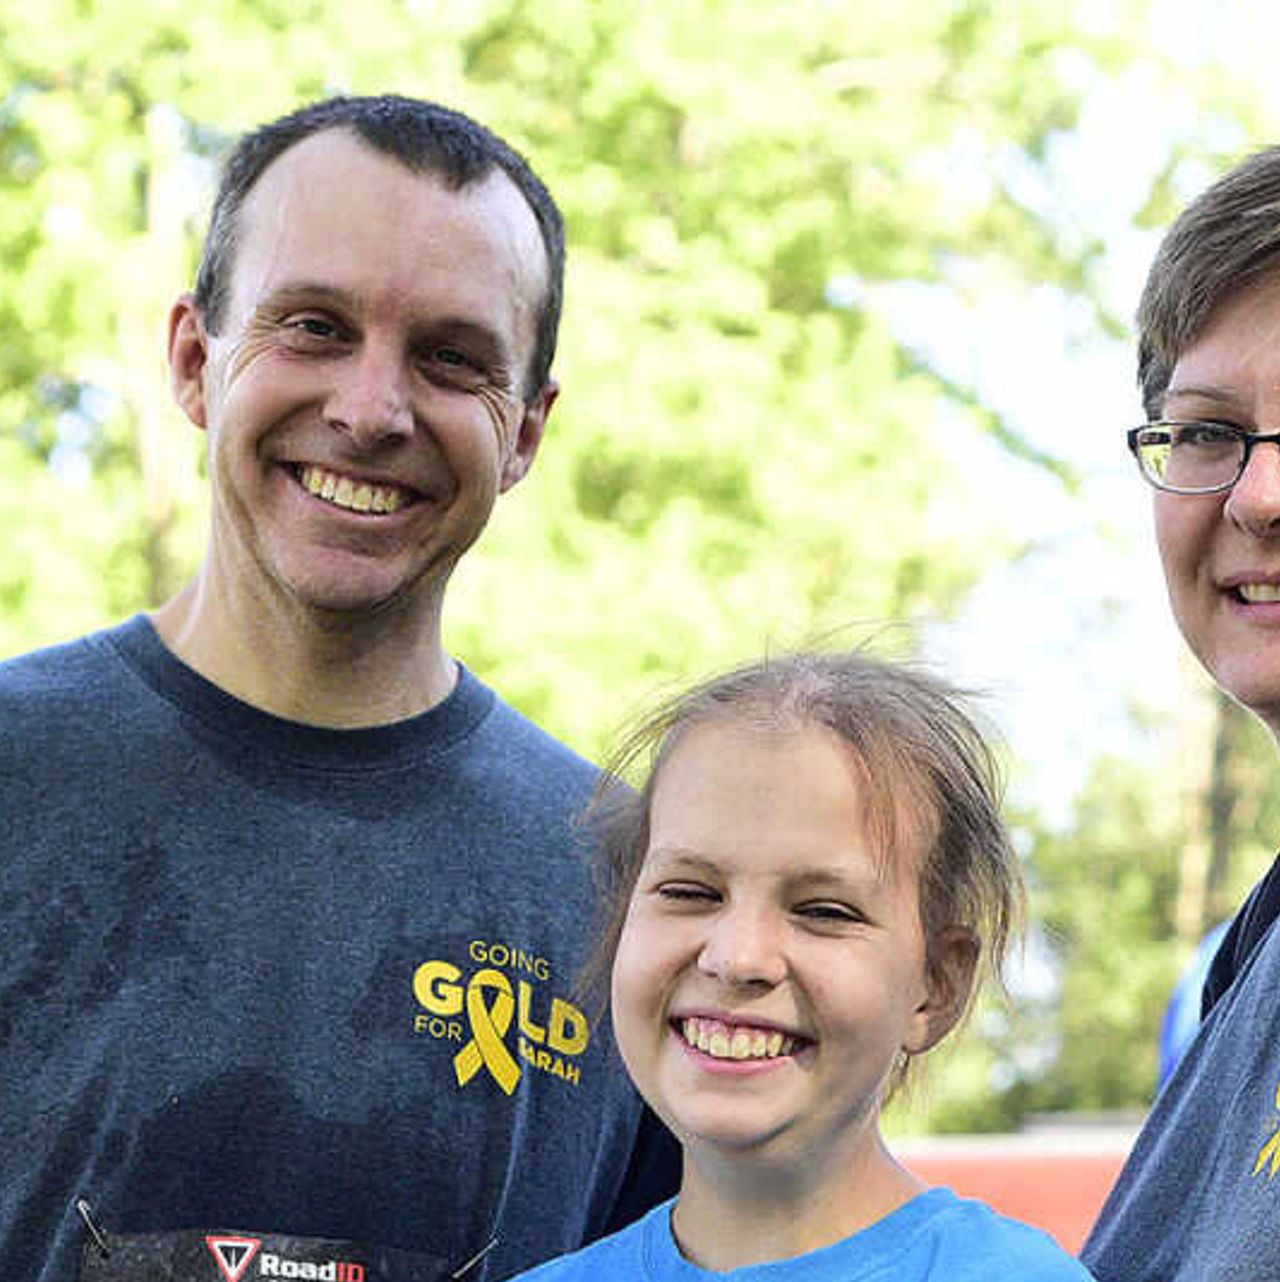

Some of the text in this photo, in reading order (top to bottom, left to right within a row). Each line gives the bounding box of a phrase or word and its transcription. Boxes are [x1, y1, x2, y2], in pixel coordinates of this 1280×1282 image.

[470, 940, 550, 980] GOING
[413, 959, 590, 1068] GOLD
[414, 1014, 463, 1042] FOR
